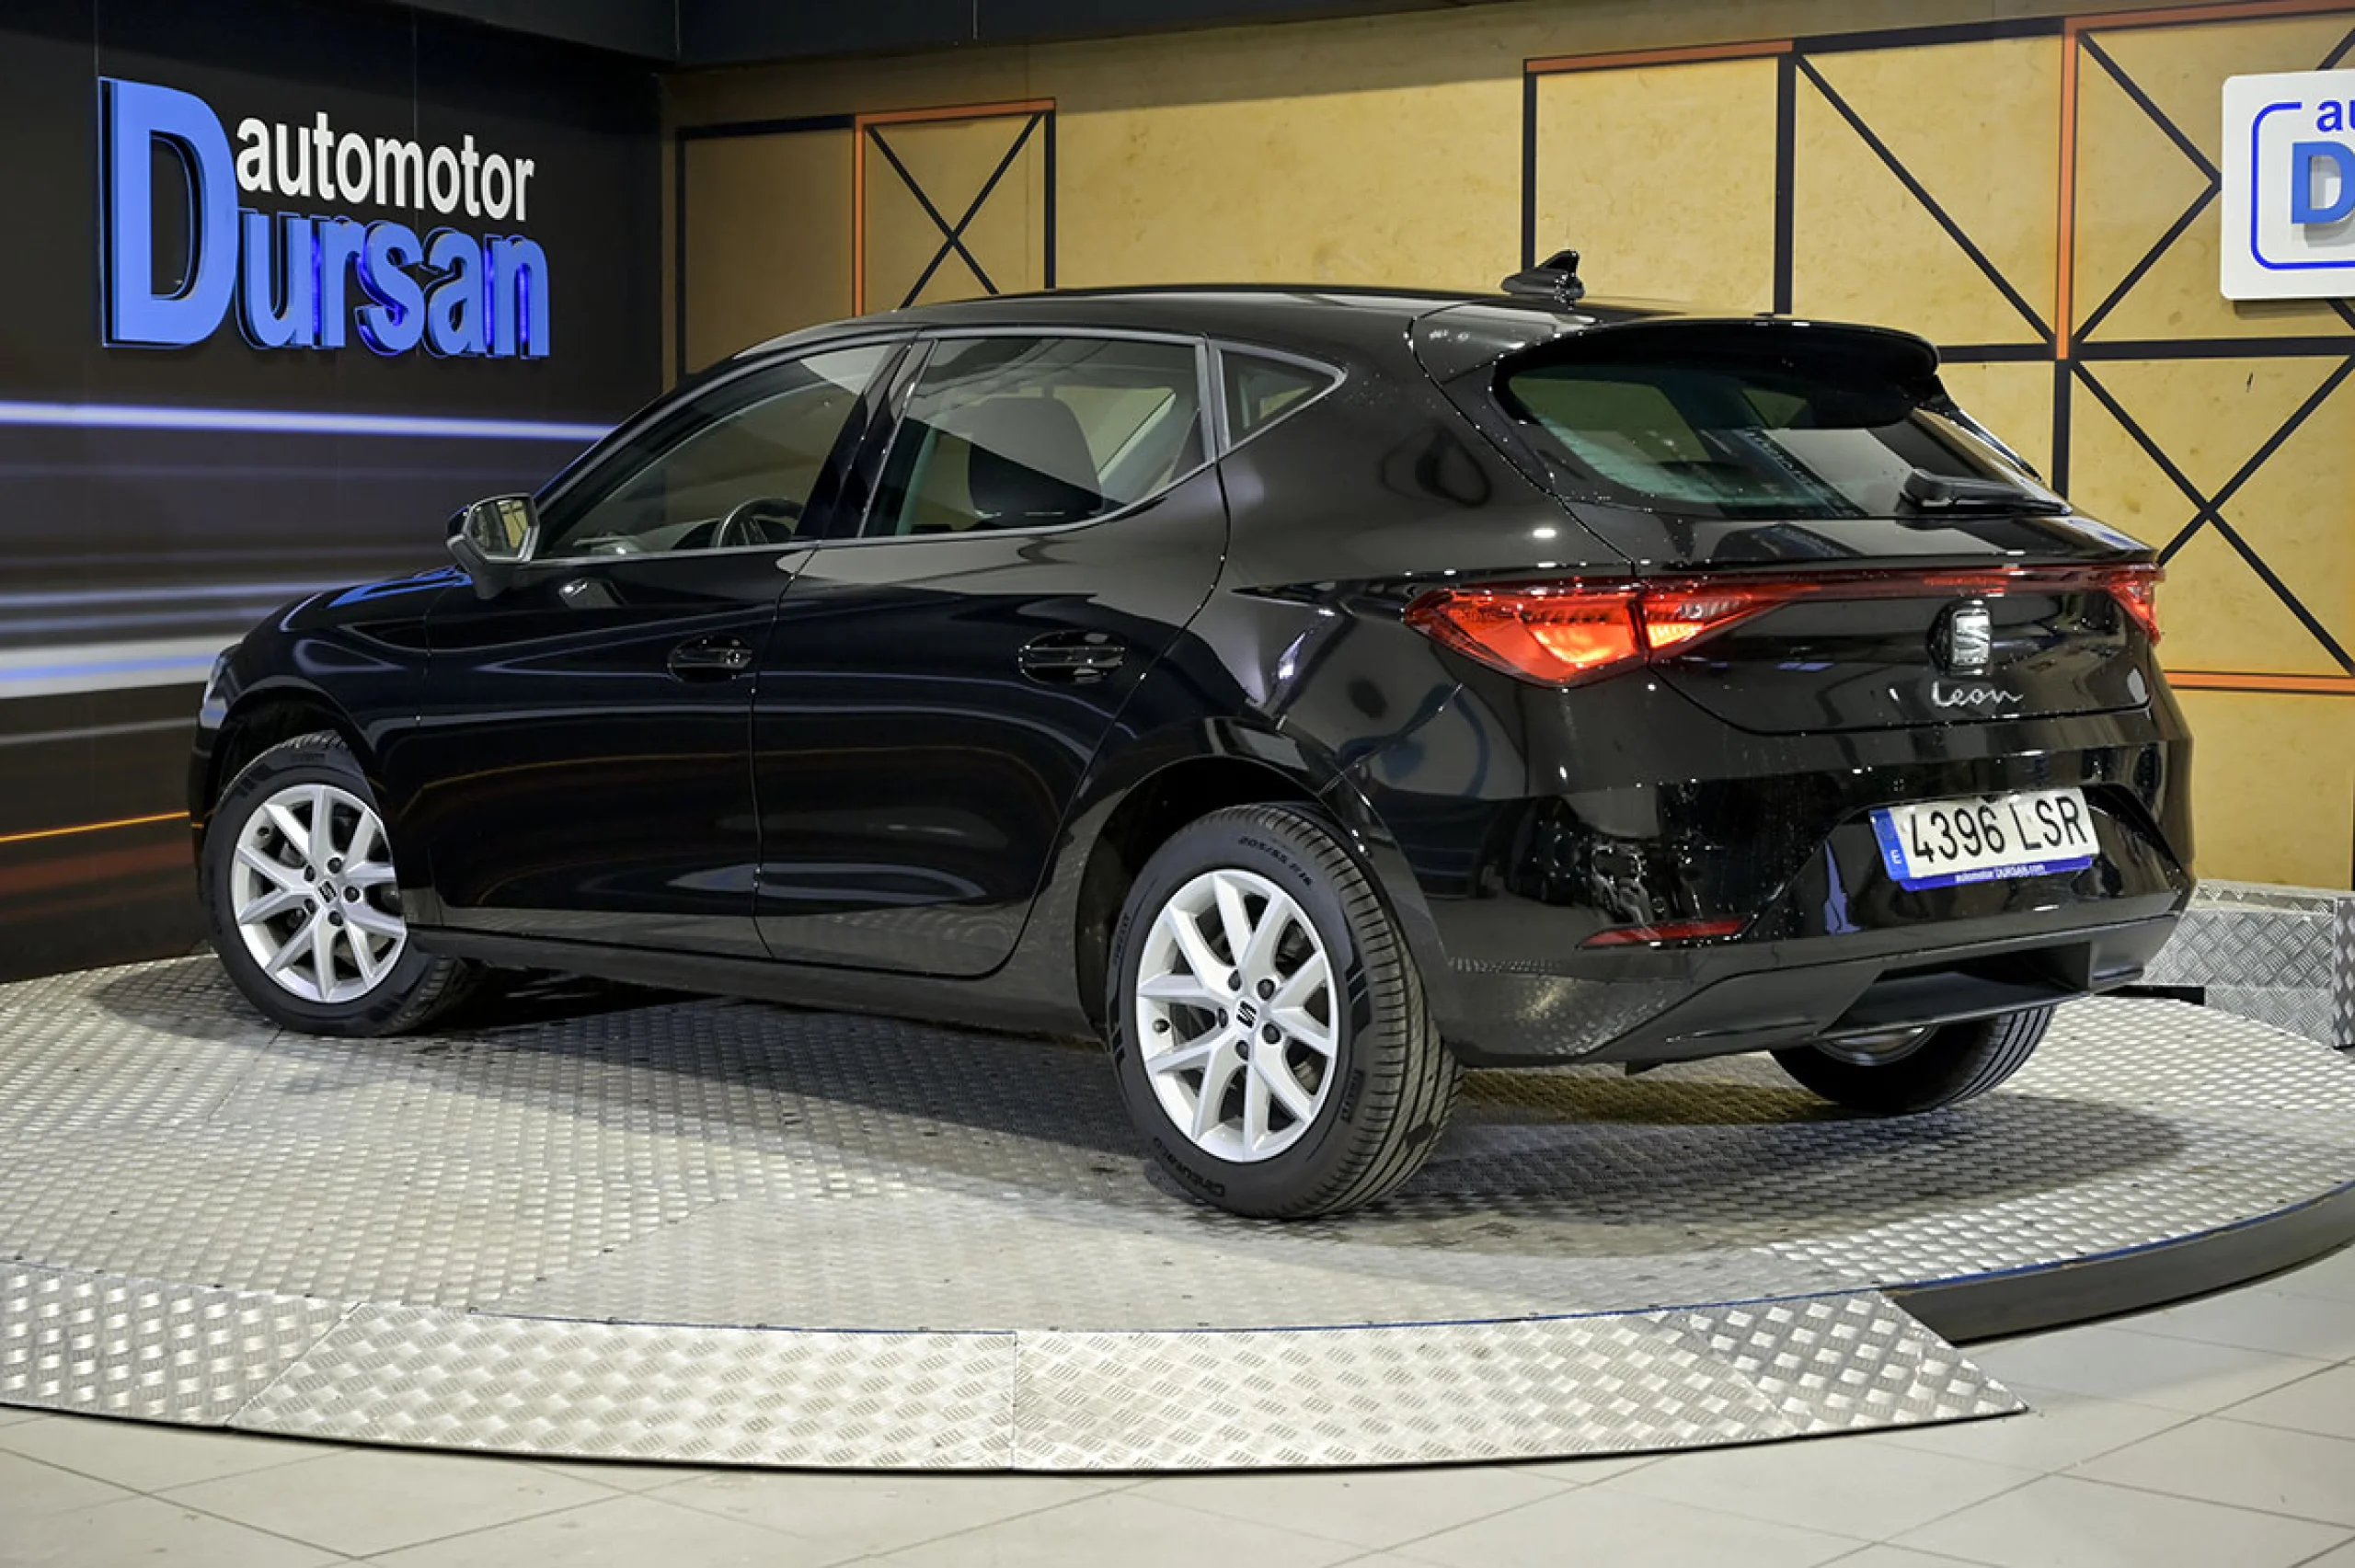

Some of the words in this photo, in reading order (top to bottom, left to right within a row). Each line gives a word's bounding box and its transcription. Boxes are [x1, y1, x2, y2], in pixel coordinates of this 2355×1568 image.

[236, 111, 535, 221] automotor
[98, 76, 550, 360] Dursan
[1932, 681, 2025, 708] Leon
[1890, 849, 1902, 864] E
[1910, 804, 2006, 863] 4396
[2009, 795, 2088, 851] LSR
